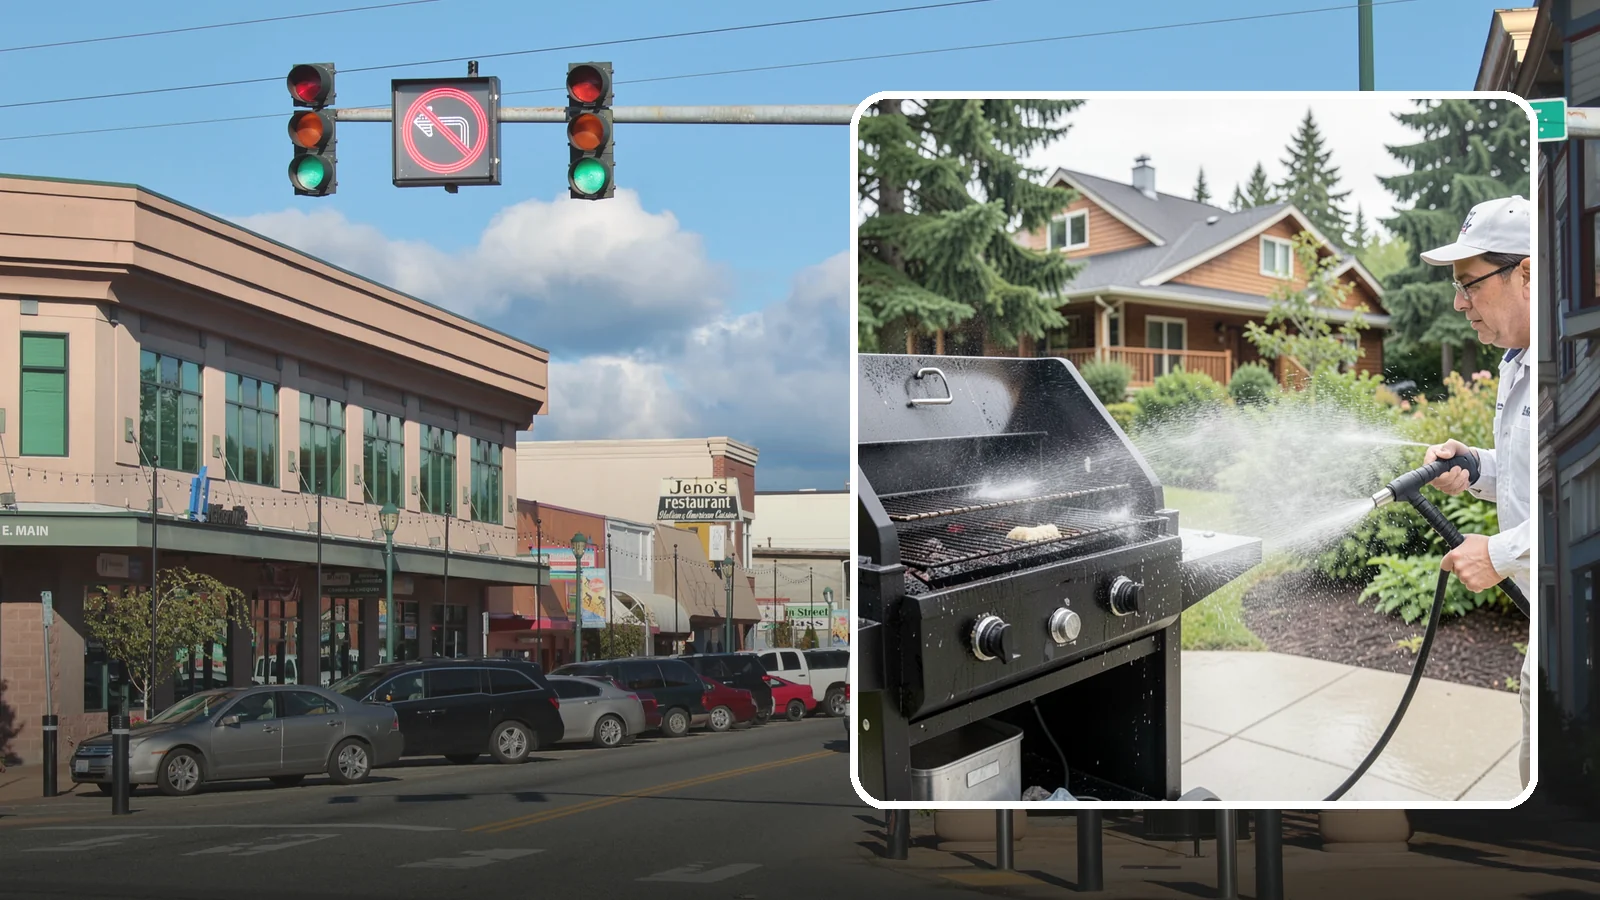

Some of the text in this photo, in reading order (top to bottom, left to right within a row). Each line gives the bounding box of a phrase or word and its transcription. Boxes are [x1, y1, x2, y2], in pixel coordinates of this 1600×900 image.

[669, 479, 728, 495] Jeno's
[665, 496, 731, 509] restaurant
[658, 510, 682, 519] Italian
[686, 510, 714, 519] American
[715, 509, 737, 519] Cuisine
[2, 525, 49, 536] E. MAIN
[797, 607, 828, 617] Street
